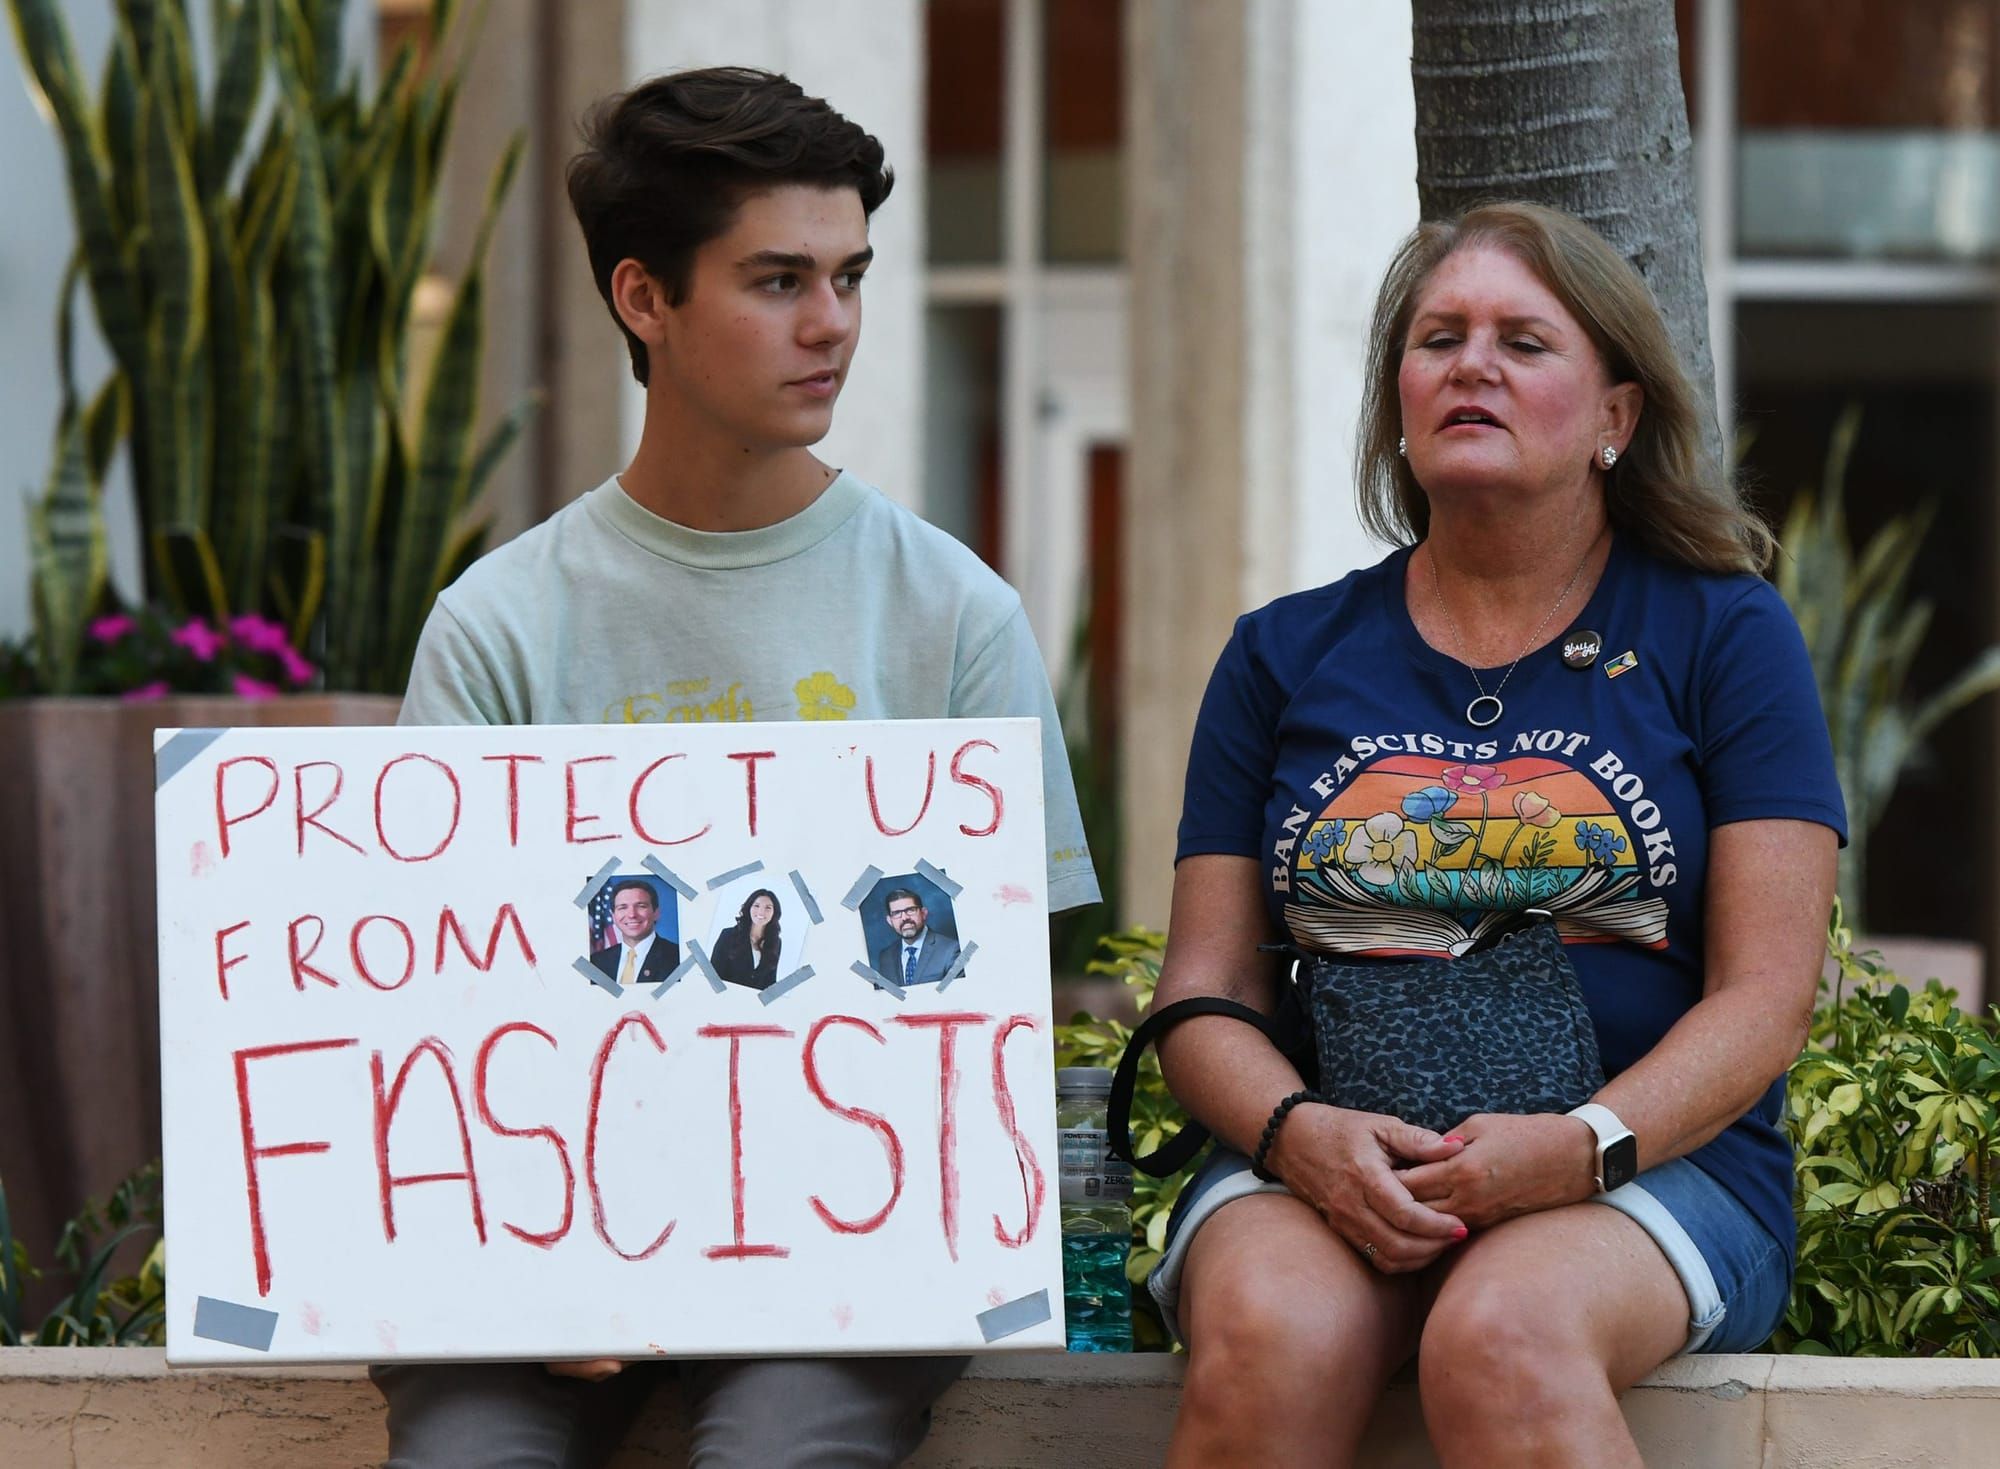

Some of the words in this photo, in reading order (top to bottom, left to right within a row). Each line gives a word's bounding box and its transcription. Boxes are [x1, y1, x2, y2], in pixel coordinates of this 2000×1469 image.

[216, 751, 776, 863] PROTECT
[864, 739, 1004, 838] US
[1272, 804, 1311, 894] BAN
[1310, 733, 1498, 801] FASCISTS
[1510, 730, 1591, 756] NOT
[1590, 750, 1678, 888] BOOKS
[216, 903, 538, 1000] FROM
[232, 1010, 1046, 1297] FASCISTS
[1104, 1175, 1127, 1185] ZERO
